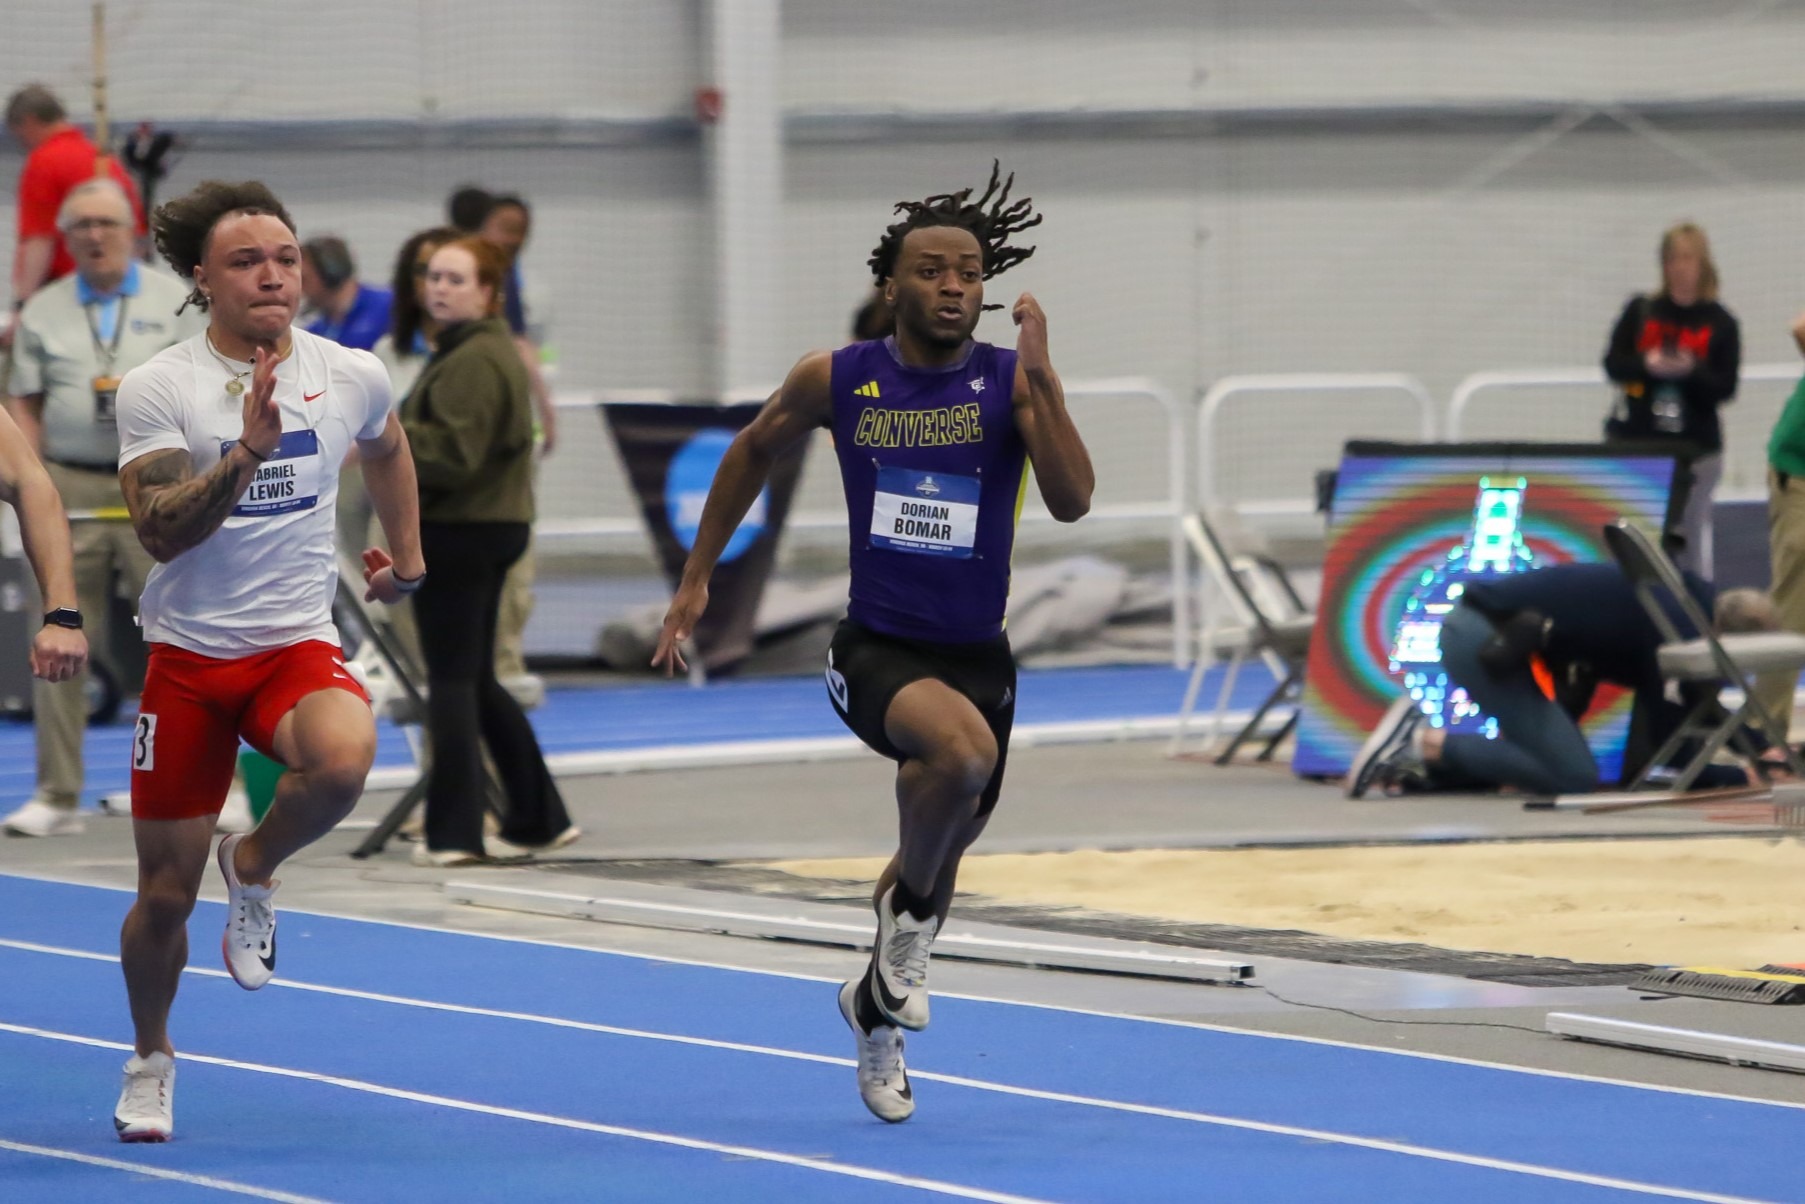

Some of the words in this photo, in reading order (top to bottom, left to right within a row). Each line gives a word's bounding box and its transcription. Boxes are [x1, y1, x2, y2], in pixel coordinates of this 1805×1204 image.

[854, 402, 983, 448] CONVERSE
[253, 464, 296, 482] ABRIEL
[249, 480, 295, 501] LEWIS
[901, 502, 949, 520] DORIAN
[894, 518, 952, 541] BOMAR
[136, 716, 150, 768] 3
